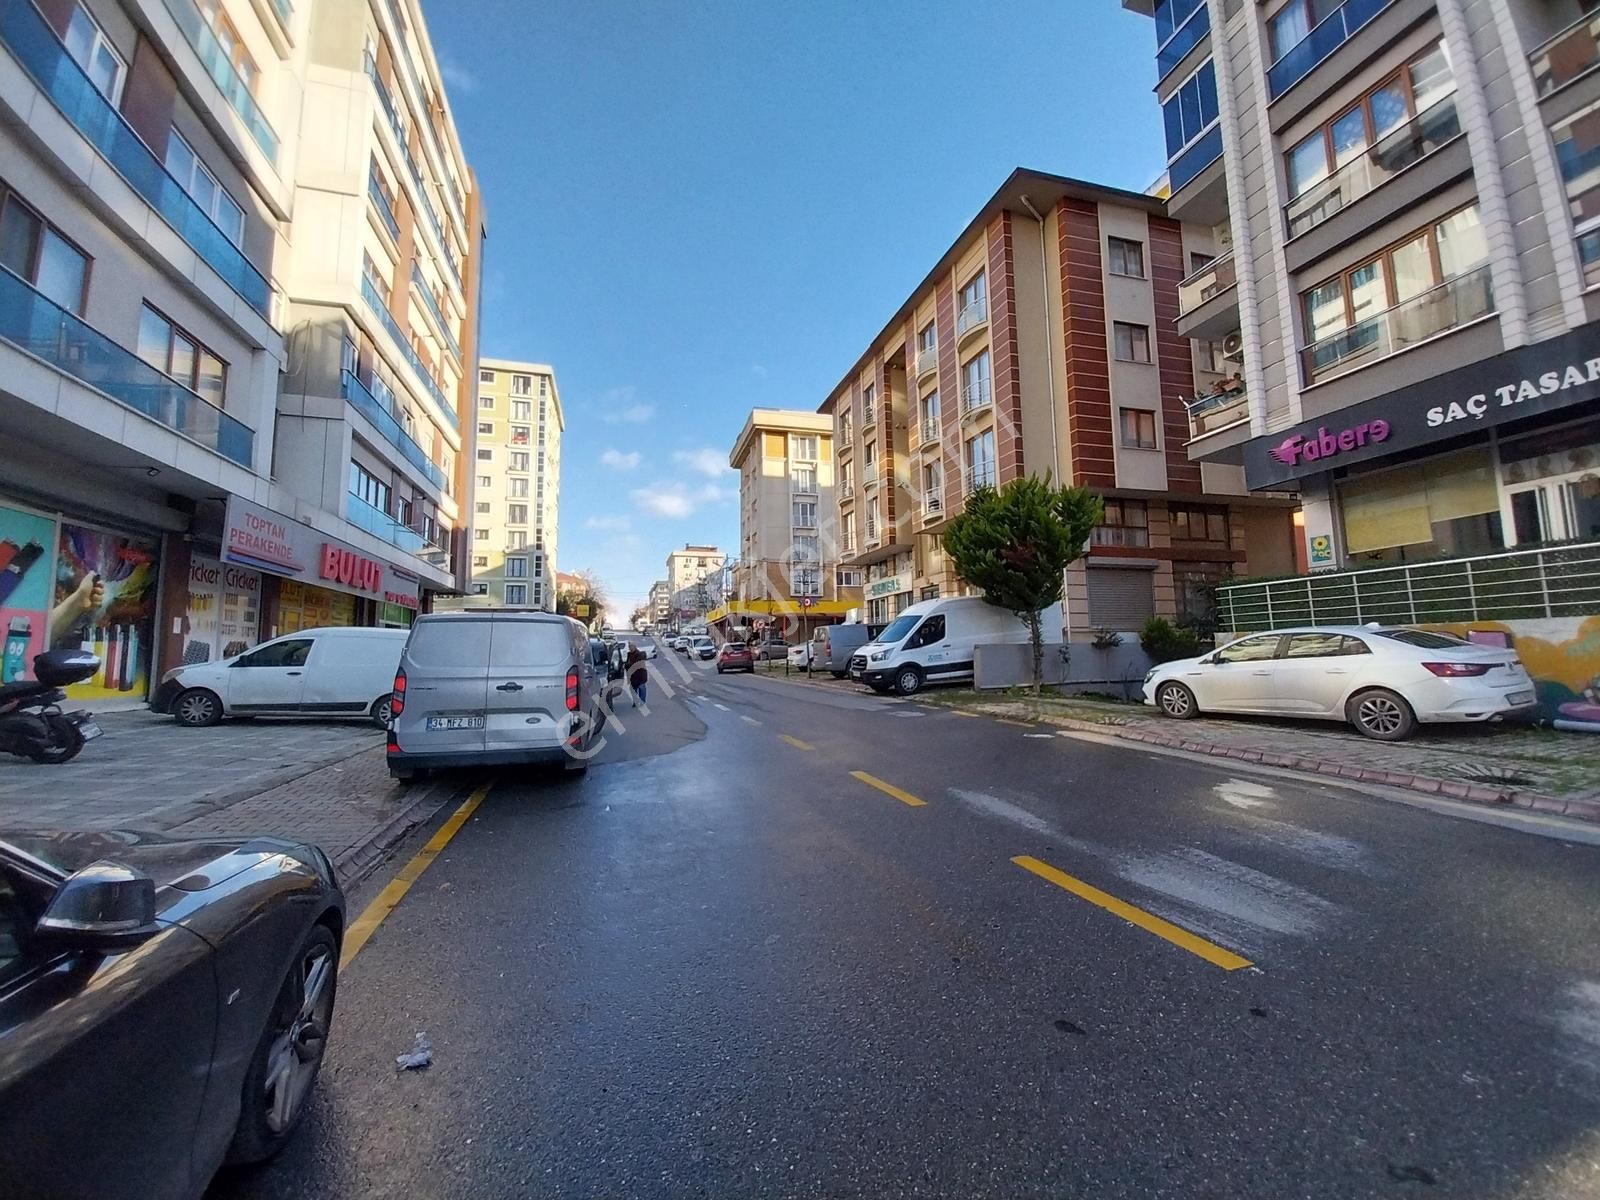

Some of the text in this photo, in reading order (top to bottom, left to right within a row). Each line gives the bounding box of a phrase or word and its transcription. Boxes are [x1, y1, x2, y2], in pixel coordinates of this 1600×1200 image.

[1426, 357, 1600, 427] SAÇ TASAR
[245, 511, 286, 540] TOPTAN
[230, 527, 293, 560] PERAKENDE
[225, 567, 259, 591] Cricket
[320, 542, 385, 593] BULUT
[467, 717, 483, 727] 810
